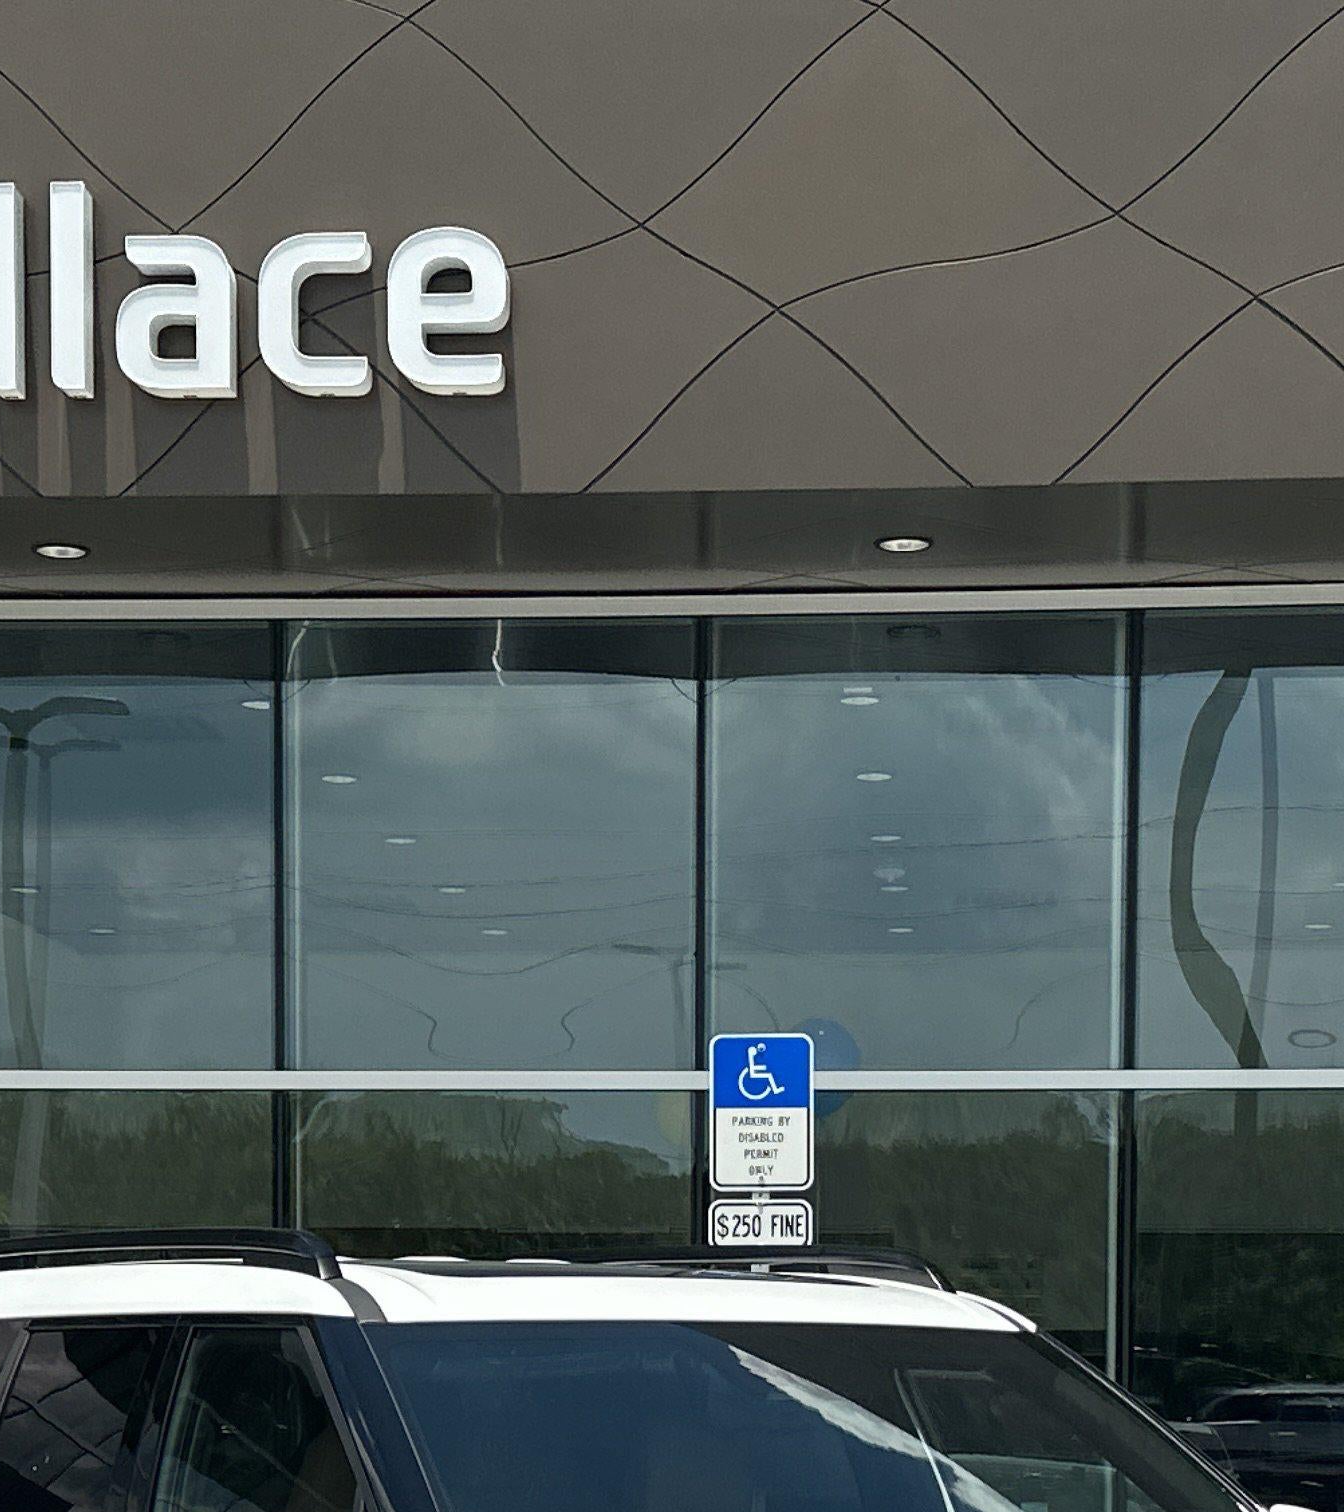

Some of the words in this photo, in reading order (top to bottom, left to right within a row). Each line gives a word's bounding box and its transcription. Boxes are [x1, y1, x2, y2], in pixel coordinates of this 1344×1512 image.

[731, 1116, 773, 1126] PARKING
[777, 1116, 790, 1126] BY
[738, 1132, 784, 1142] DISABLED
[743, 1149, 778, 1159] PERMIT
[748, 1165, 774, 1175] ONLY
[717, 1213, 762, 1240] $250
[770, 1214, 804, 1237] FINE
